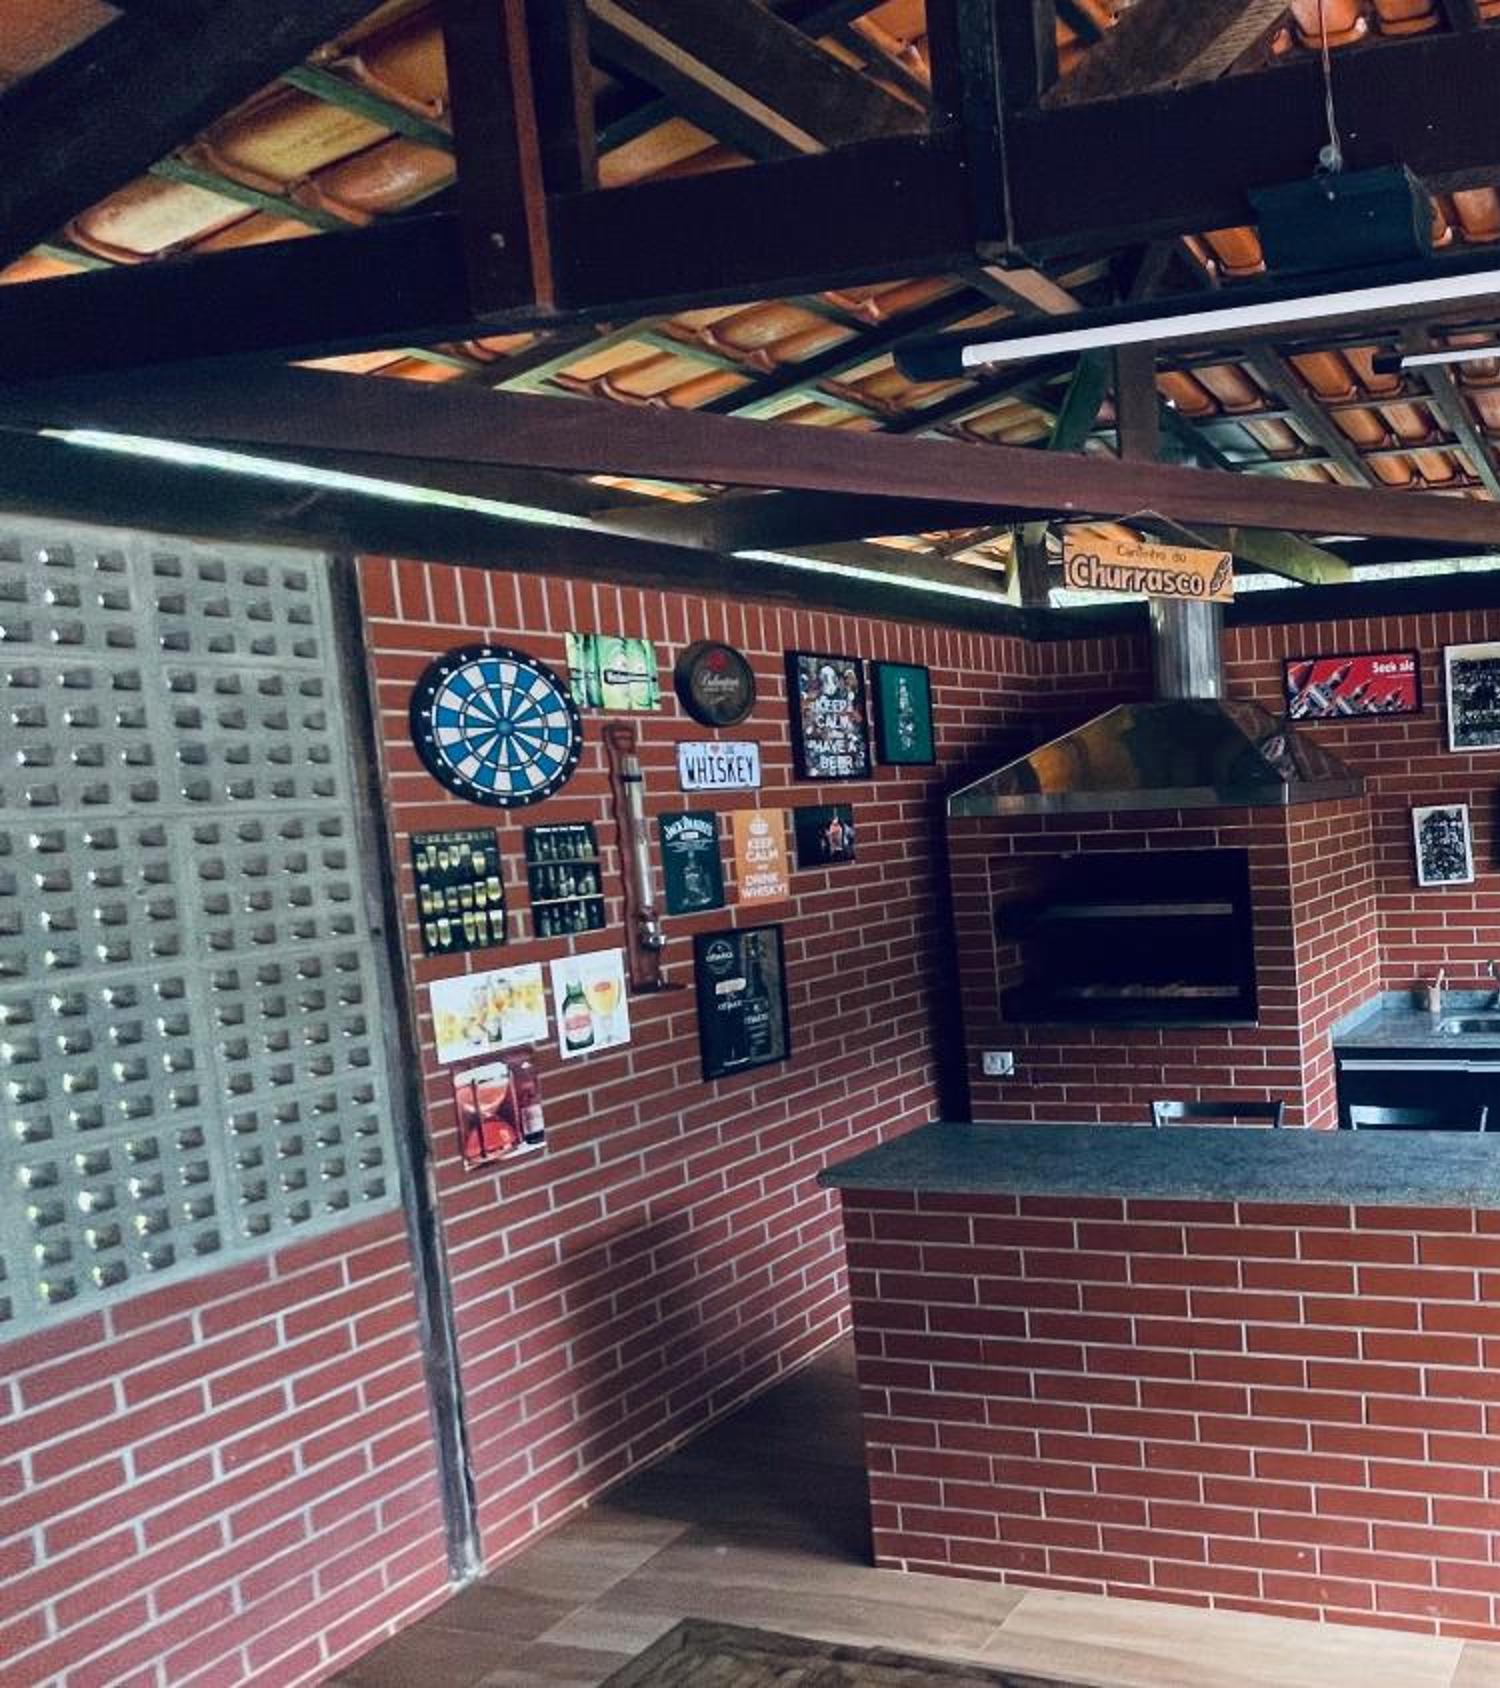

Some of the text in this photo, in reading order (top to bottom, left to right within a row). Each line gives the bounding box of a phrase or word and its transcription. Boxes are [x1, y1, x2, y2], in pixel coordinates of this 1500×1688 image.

[1069, 553, 1206, 596] Churrasco
[815, 714, 850, 729] CALM
[685, 756, 754, 783] WHISKEY
